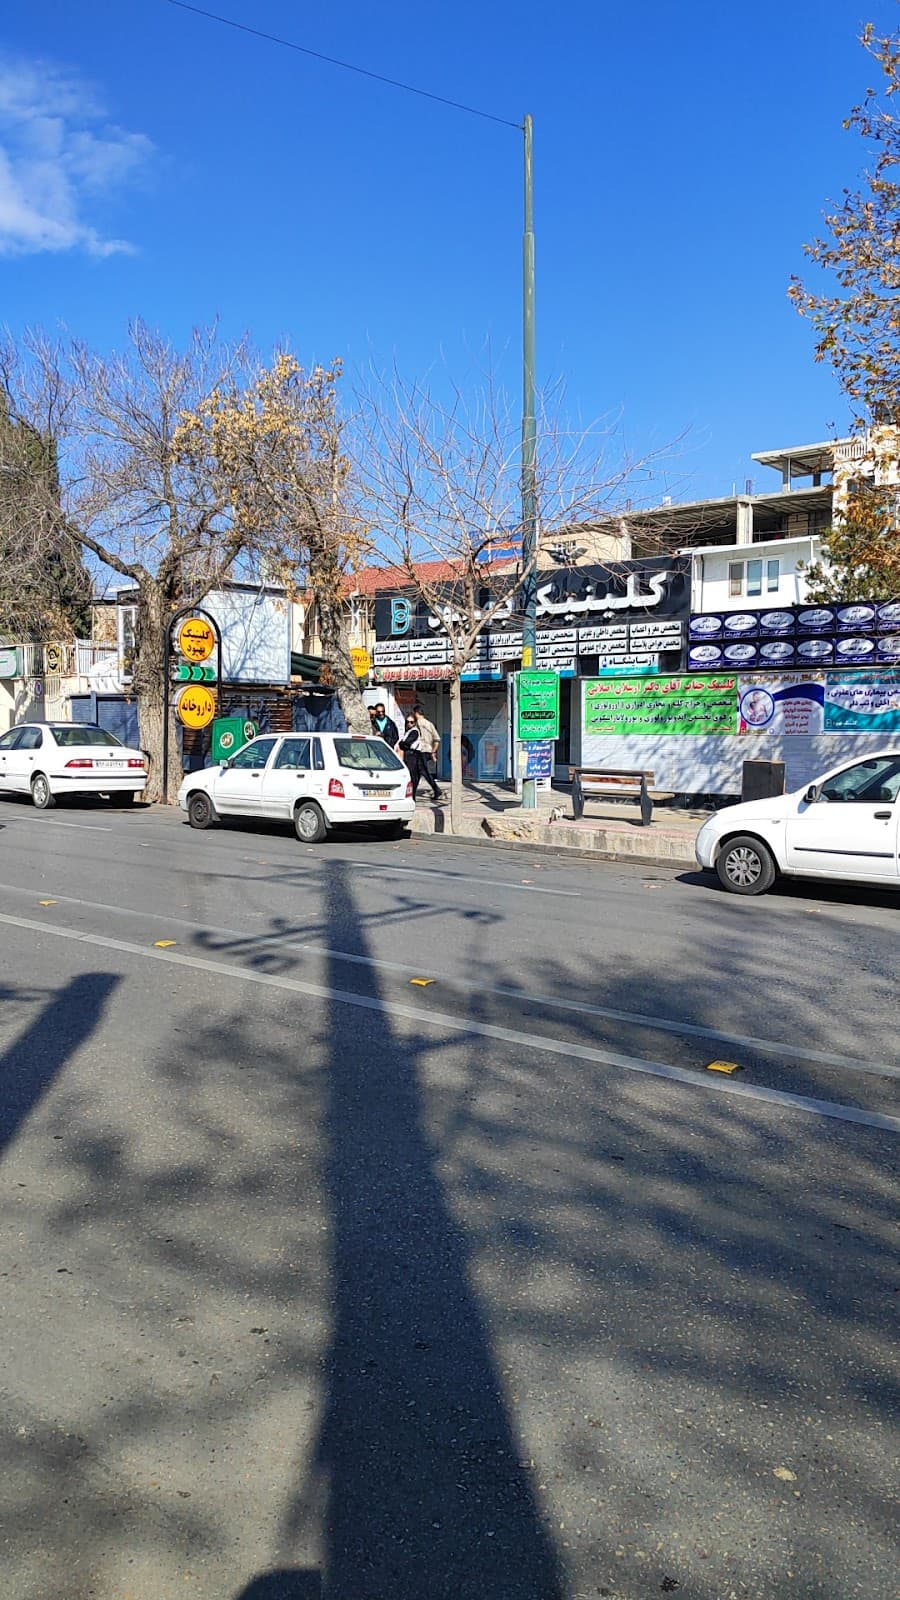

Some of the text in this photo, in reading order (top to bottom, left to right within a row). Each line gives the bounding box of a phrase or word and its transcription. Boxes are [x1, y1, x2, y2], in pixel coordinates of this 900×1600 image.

[534, 572, 669, 622] کلینیک
[596, 626, 609, 638] داخلی
[609, 627, 626, 637] متخصص
[651, 625, 661, 636] مغز
[660, 623, 681, 634] متخصص
[182, 628, 210, 643] کلینیک
[550, 631, 574, 641] متخصص
[424, 641, 443, 649] متخصص
[608, 642, 626, 652] متخصص
[663, 640, 680, 649] متخصص
[186, 644, 206, 657] بهبود
[551, 646, 574, 656] متخصص
[424, 654, 443, 663] متخصص
[608, 654, 656, 668] آزمایشگاه
[615, 682, 641, 695] ارسلان
[643, 682, 660, 694] دکتر
[661, 679, 682, 694] آقای
[684, 681, 705, 692] جناب
[707, 679, 735, 690] کلینیک
[830, 689, 849, 698] عفونی
[849, 689, 863, 697] های
[864, 688, 886, 697] بیماری
[181, 698, 212, 716] داروخانه
[706, 701, 733, 709] متخصص
[874, 699, 890, 708] اخلی
